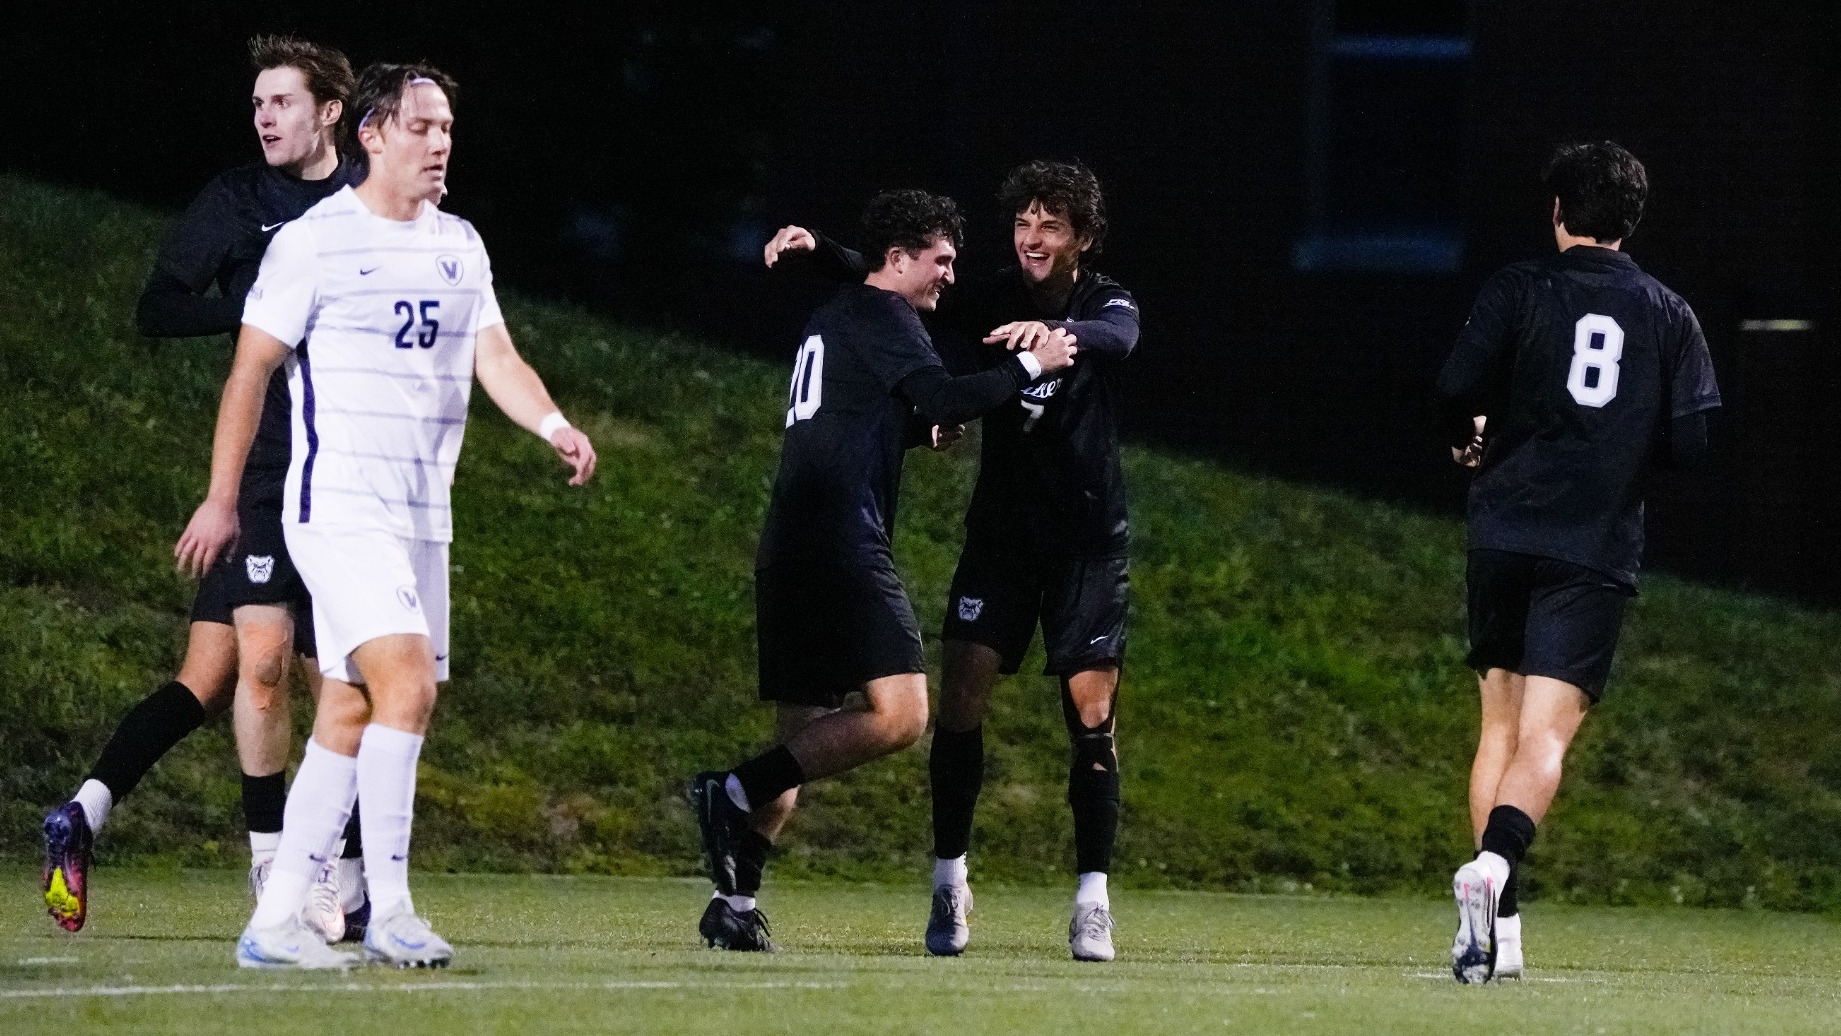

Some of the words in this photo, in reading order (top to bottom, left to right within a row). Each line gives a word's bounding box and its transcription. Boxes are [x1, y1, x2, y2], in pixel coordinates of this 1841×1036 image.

[394, 300, 439, 349] 25
[1567, 313, 1624, 408] 8
[1021, 399, 1044, 432] 7
